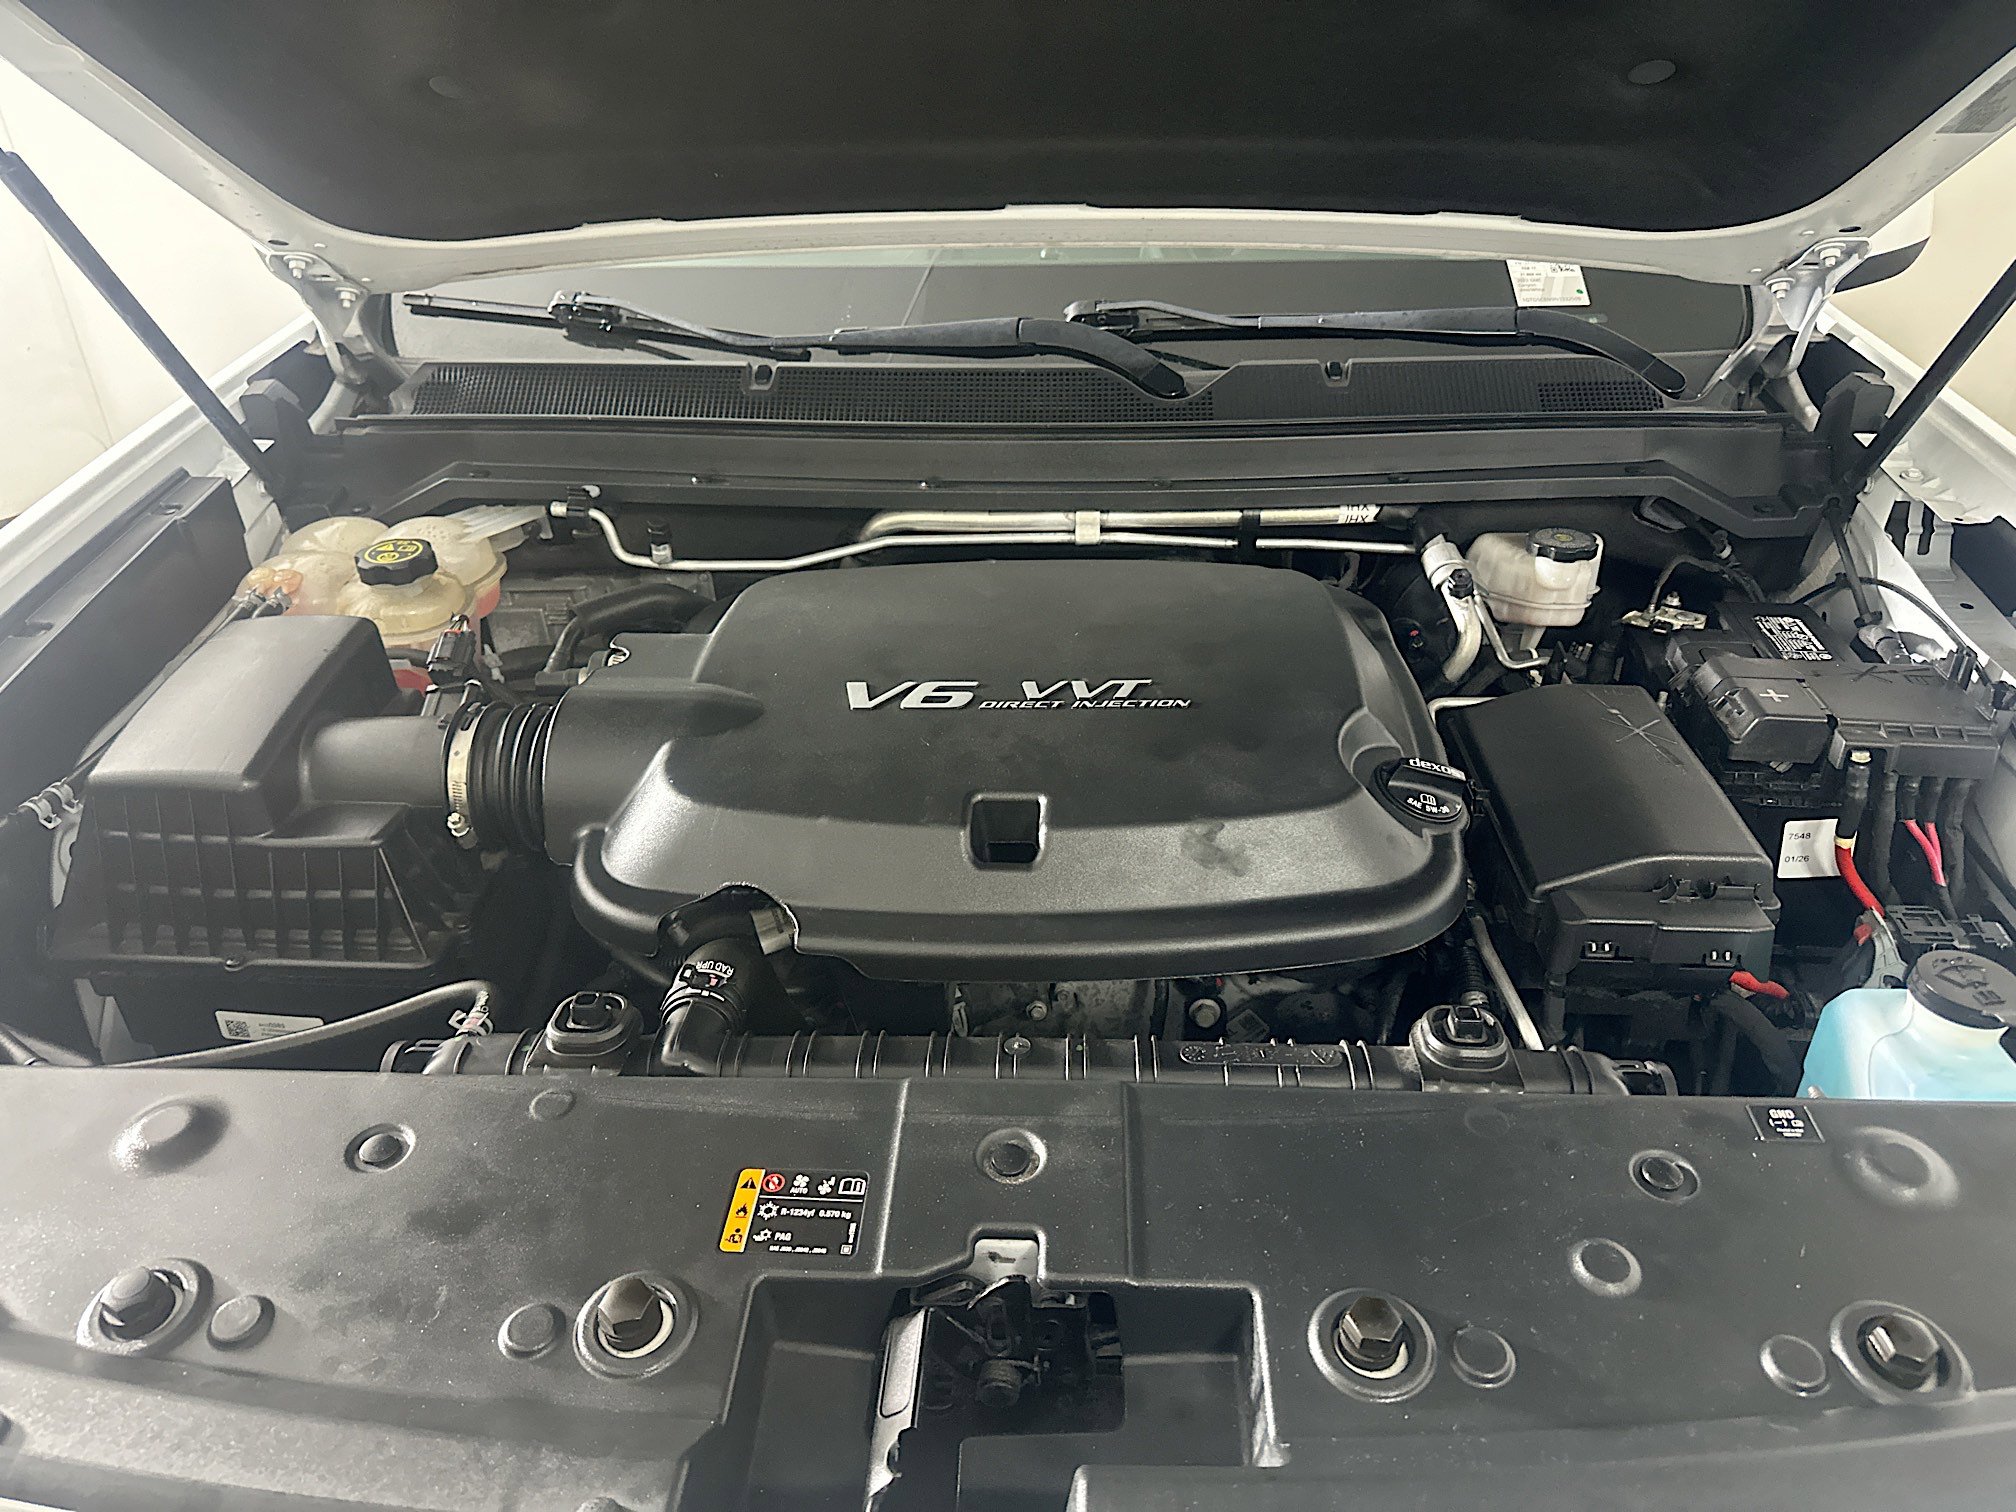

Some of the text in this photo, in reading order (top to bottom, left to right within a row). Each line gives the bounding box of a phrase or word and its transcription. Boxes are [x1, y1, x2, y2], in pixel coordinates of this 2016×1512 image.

[846, 679, 1153, 710] V6 VVT
[978, 699, 1191, 709] DIRECT INJECTION
[1406, 797, 1423, 809] SAE
[1788, 832, 1811, 840] 7548
[1784, 855, 1810, 863] 01/26
[695, 960, 734, 976] RAD UPR
[1768, 1108, 1795, 1119] GND
[780, 1207, 815, 1218] R-1234yf
[841, 1210, 852, 1220] kg
[774, 1231, 792, 1241] PAG
